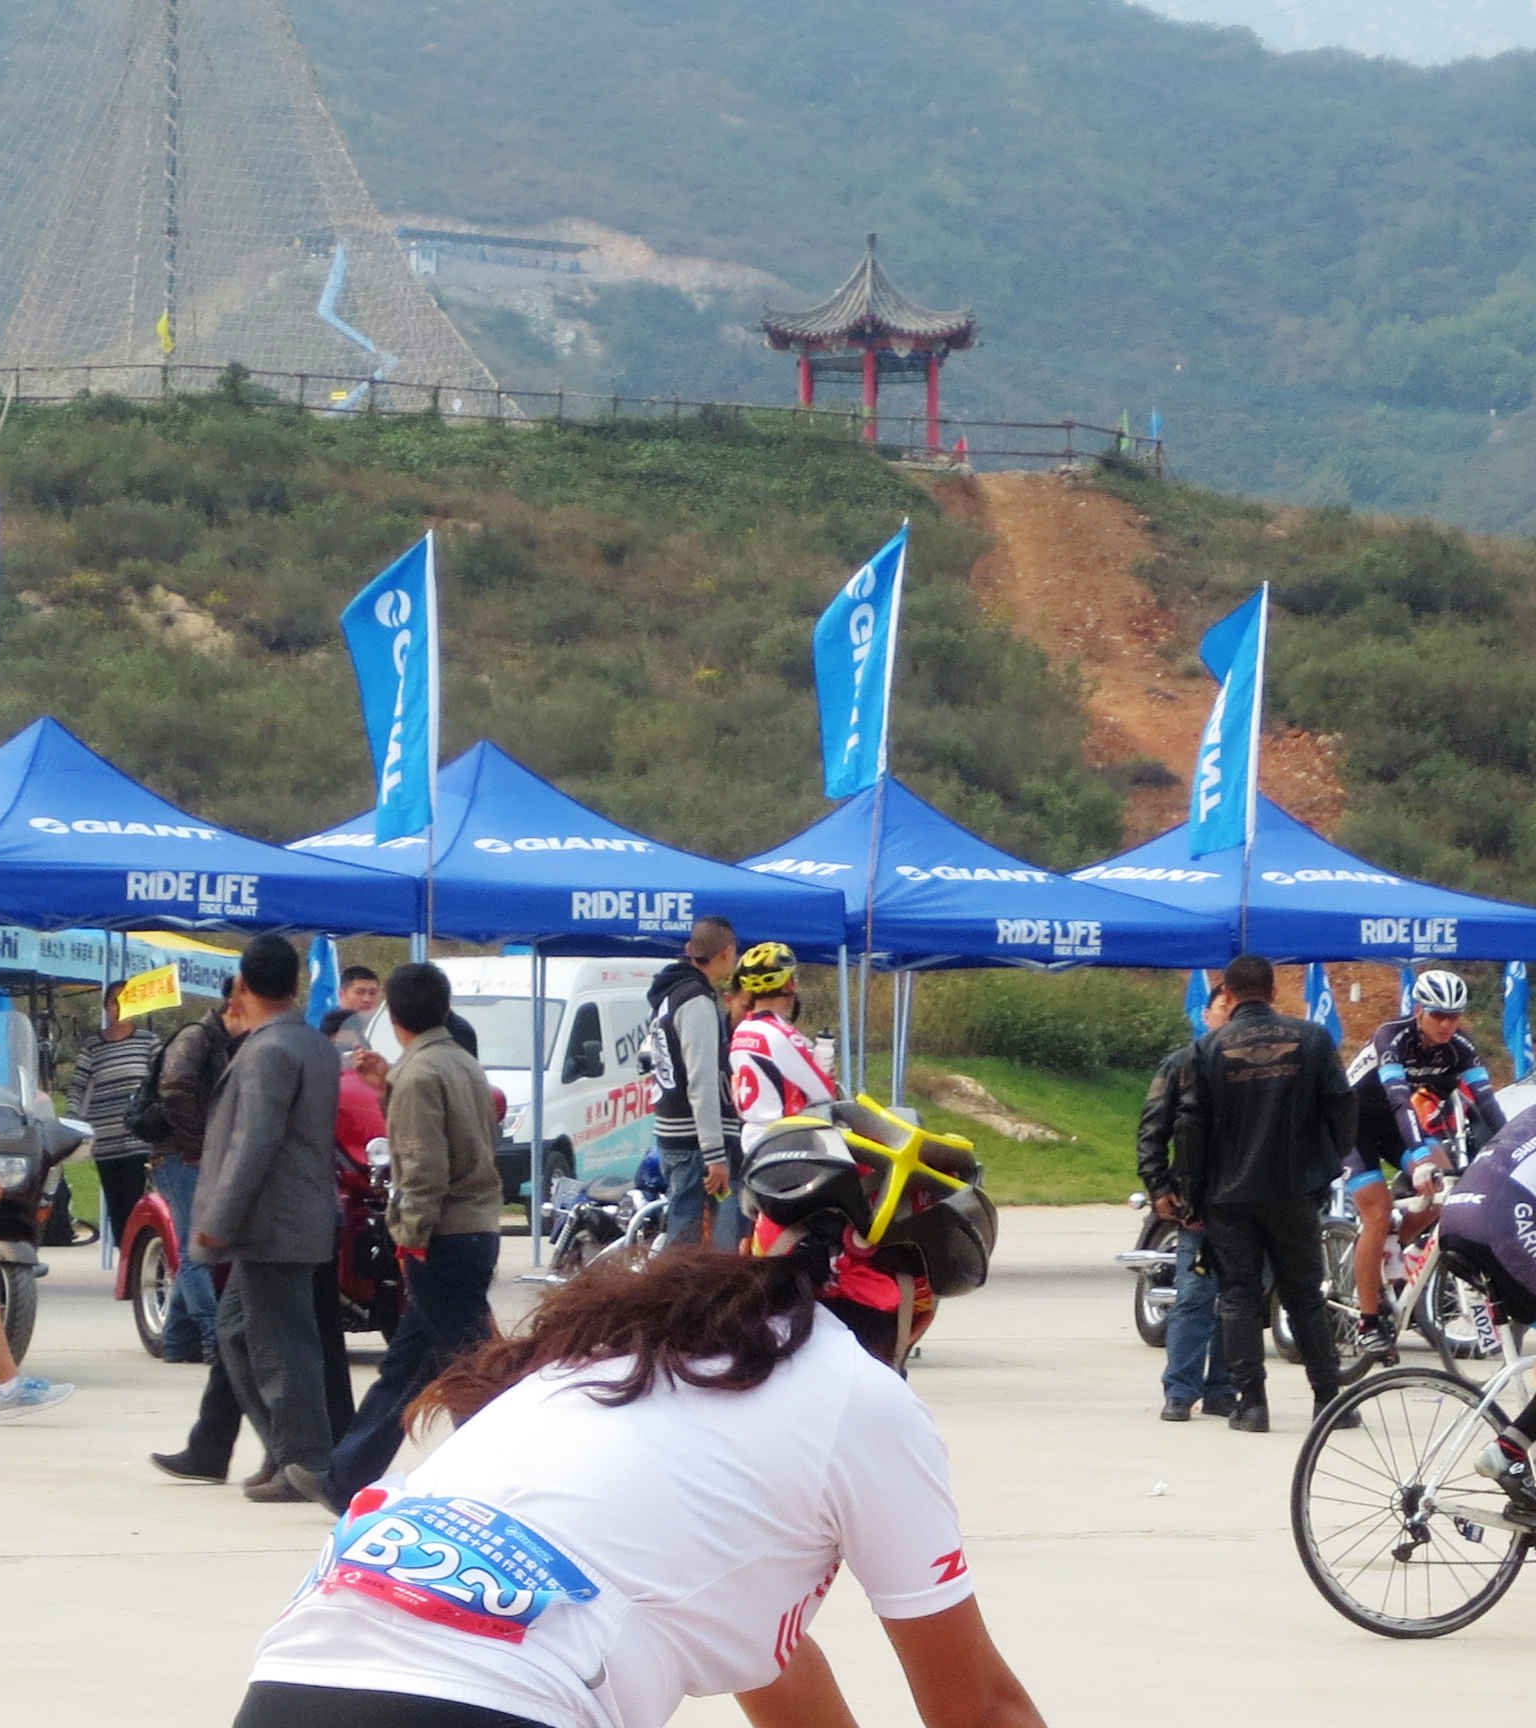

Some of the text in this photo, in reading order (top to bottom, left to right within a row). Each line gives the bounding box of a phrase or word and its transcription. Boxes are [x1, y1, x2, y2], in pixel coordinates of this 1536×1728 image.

[71, 819, 217, 840] GIANT
[514, 838, 645, 854] GIANT
[930, 866, 1050, 882] GIANT
[1294, 869, 1404, 886] GIANT
[126, 871, 259, 905] RIDE LIFE
[198, 902, 259, 917] RIDE GIANT
[571, 891, 694, 922] RIDE LIFE
[996, 918, 1102, 946] RIDE LIFE
[1361, 918, 1458, 945] RIDE LIFE
[1471, 1303, 1496, 1349] A024
